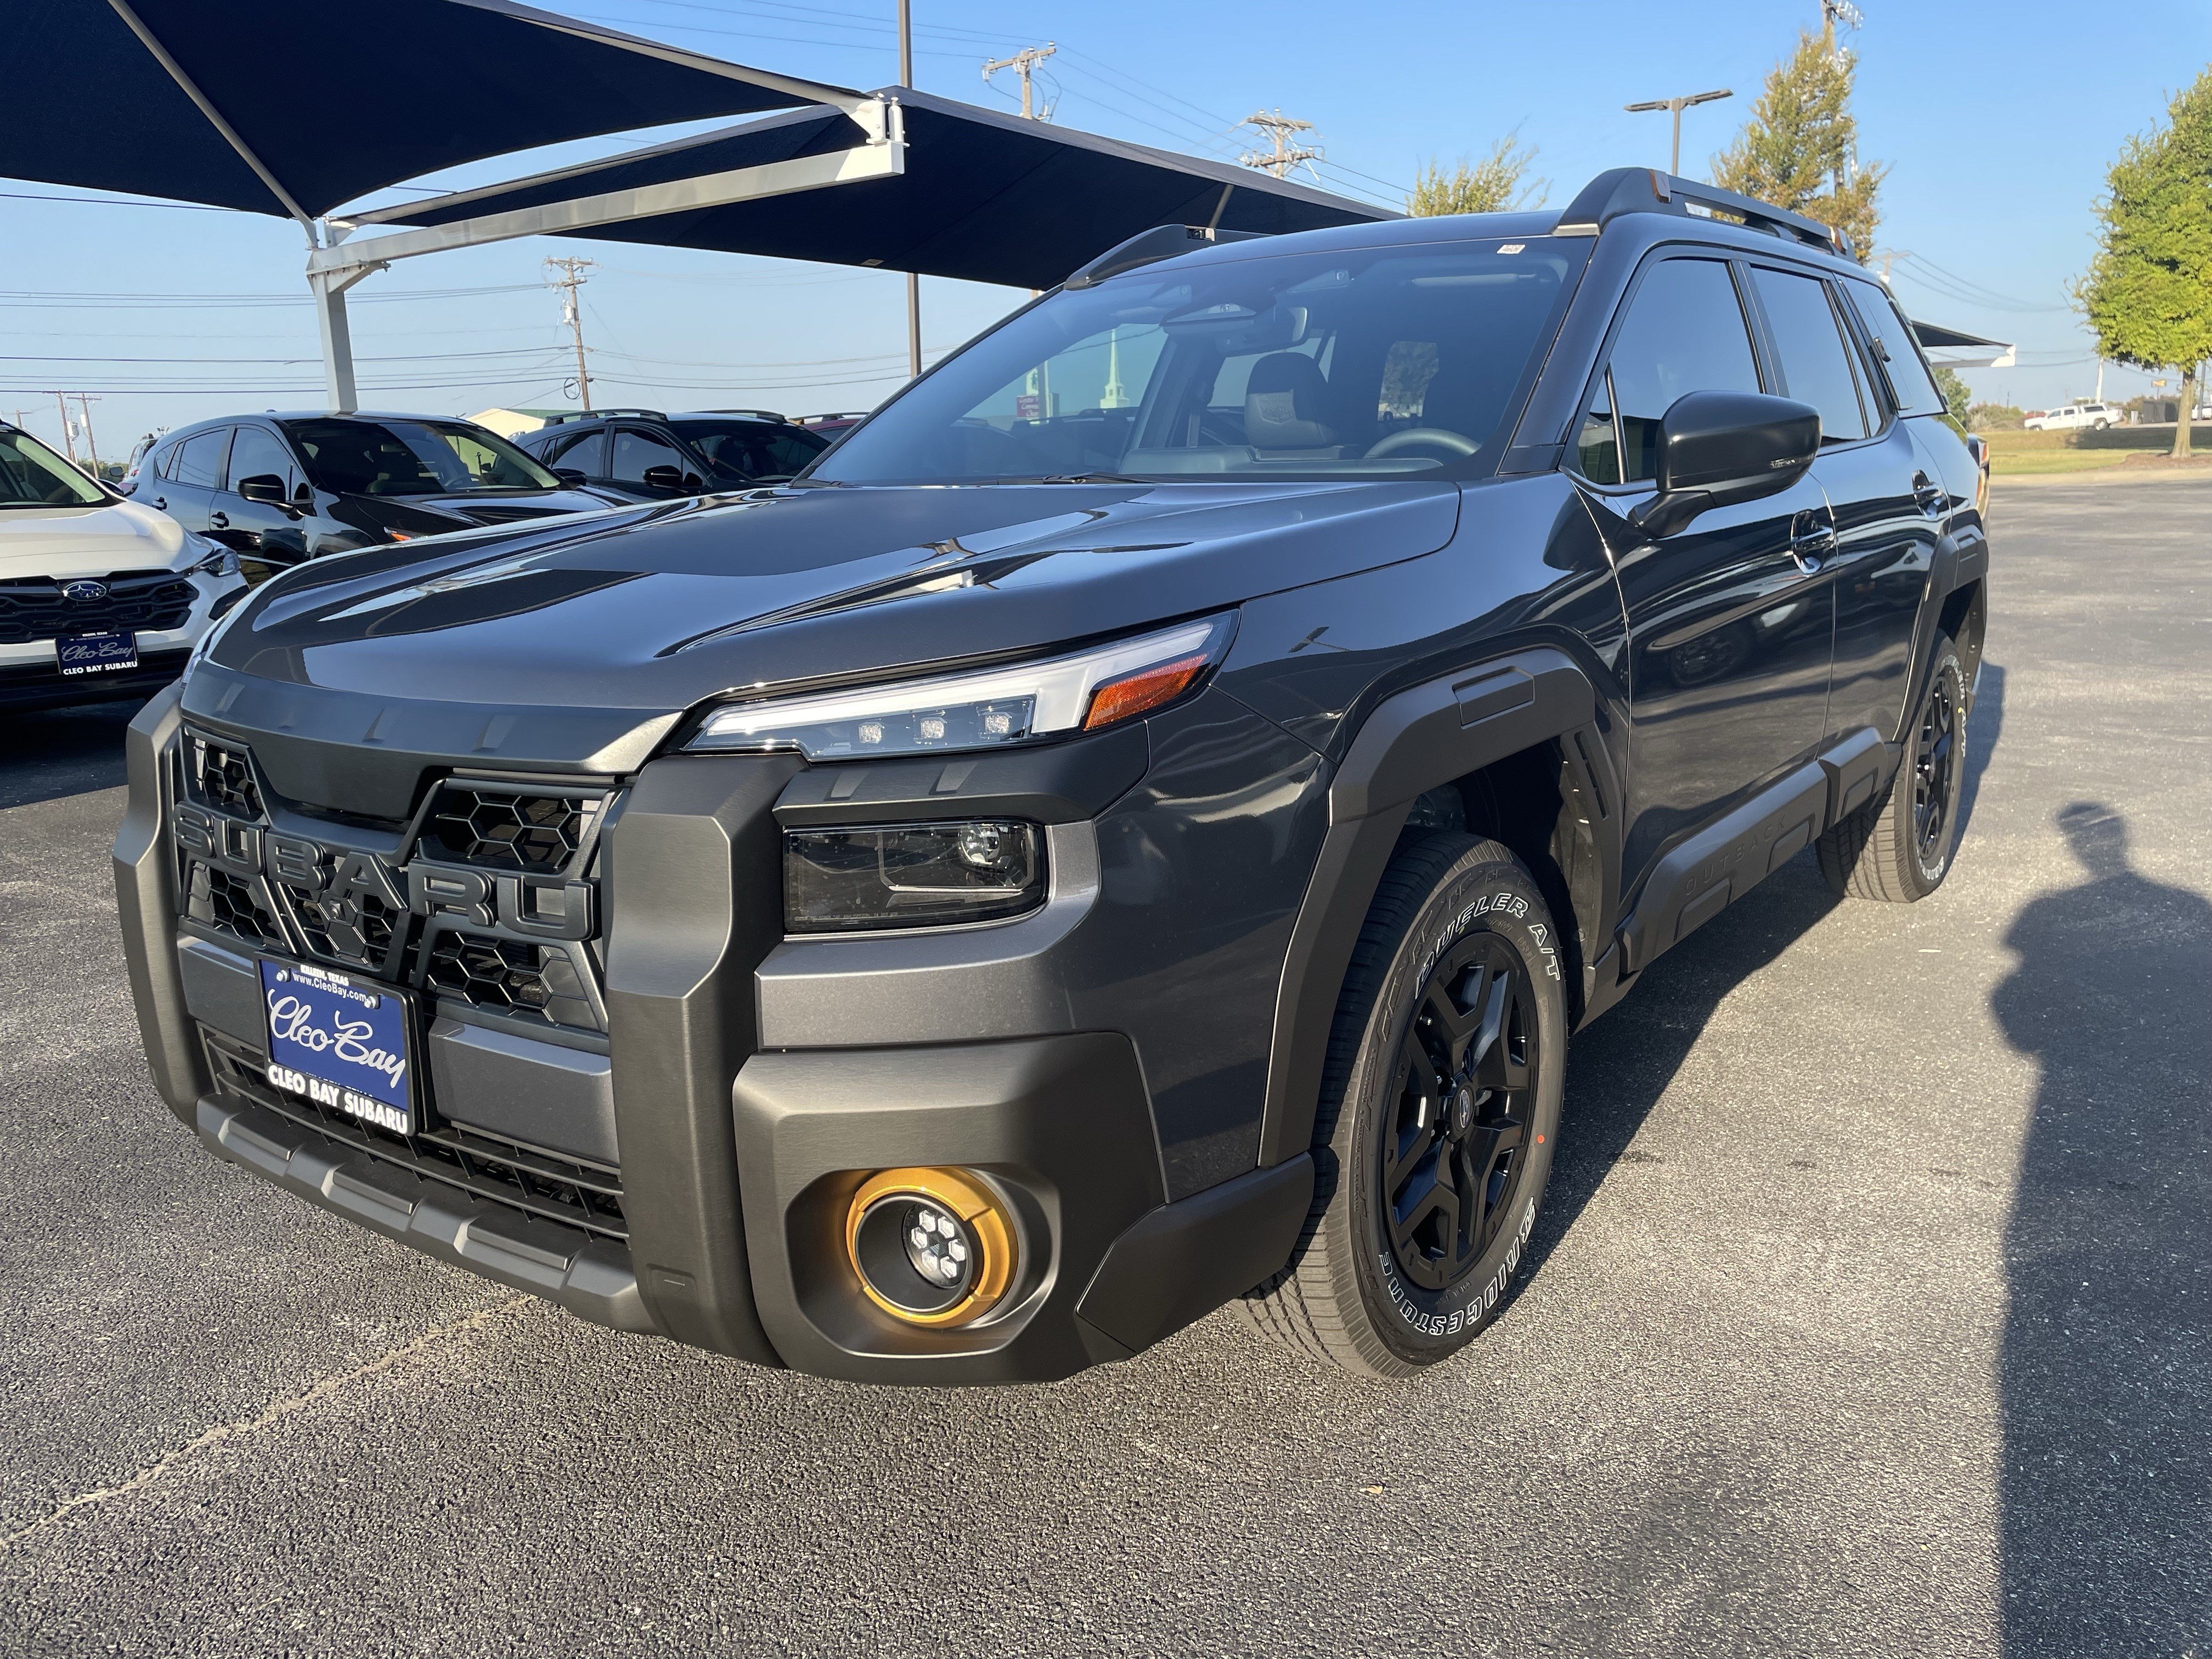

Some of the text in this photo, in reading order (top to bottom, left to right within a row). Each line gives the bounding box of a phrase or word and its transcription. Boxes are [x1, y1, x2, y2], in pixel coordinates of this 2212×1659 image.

[61, 642, 133, 662] Cleo Bay
[63, 661, 138, 675] CLEO BAY SUBARU
[174, 800, 601, 941] SUBARU
[1686, 815, 1785, 896] OUTBACK
[300, 964, 349, 986] KILLEEN, TEXAS
[1415, 893, 1560, 1000] DUELER A/T
[293, 972, 367, 1003] www.CleoBay.com
[268, 989, 406, 1088] Cleo Bay
[268, 1065, 306, 1094] CLEO
[309, 1079, 340, 1107] BAY
[344, 1092, 408, 1134] SUBARU
[1378, 1197, 1536, 1335] BRIDGESTONE
